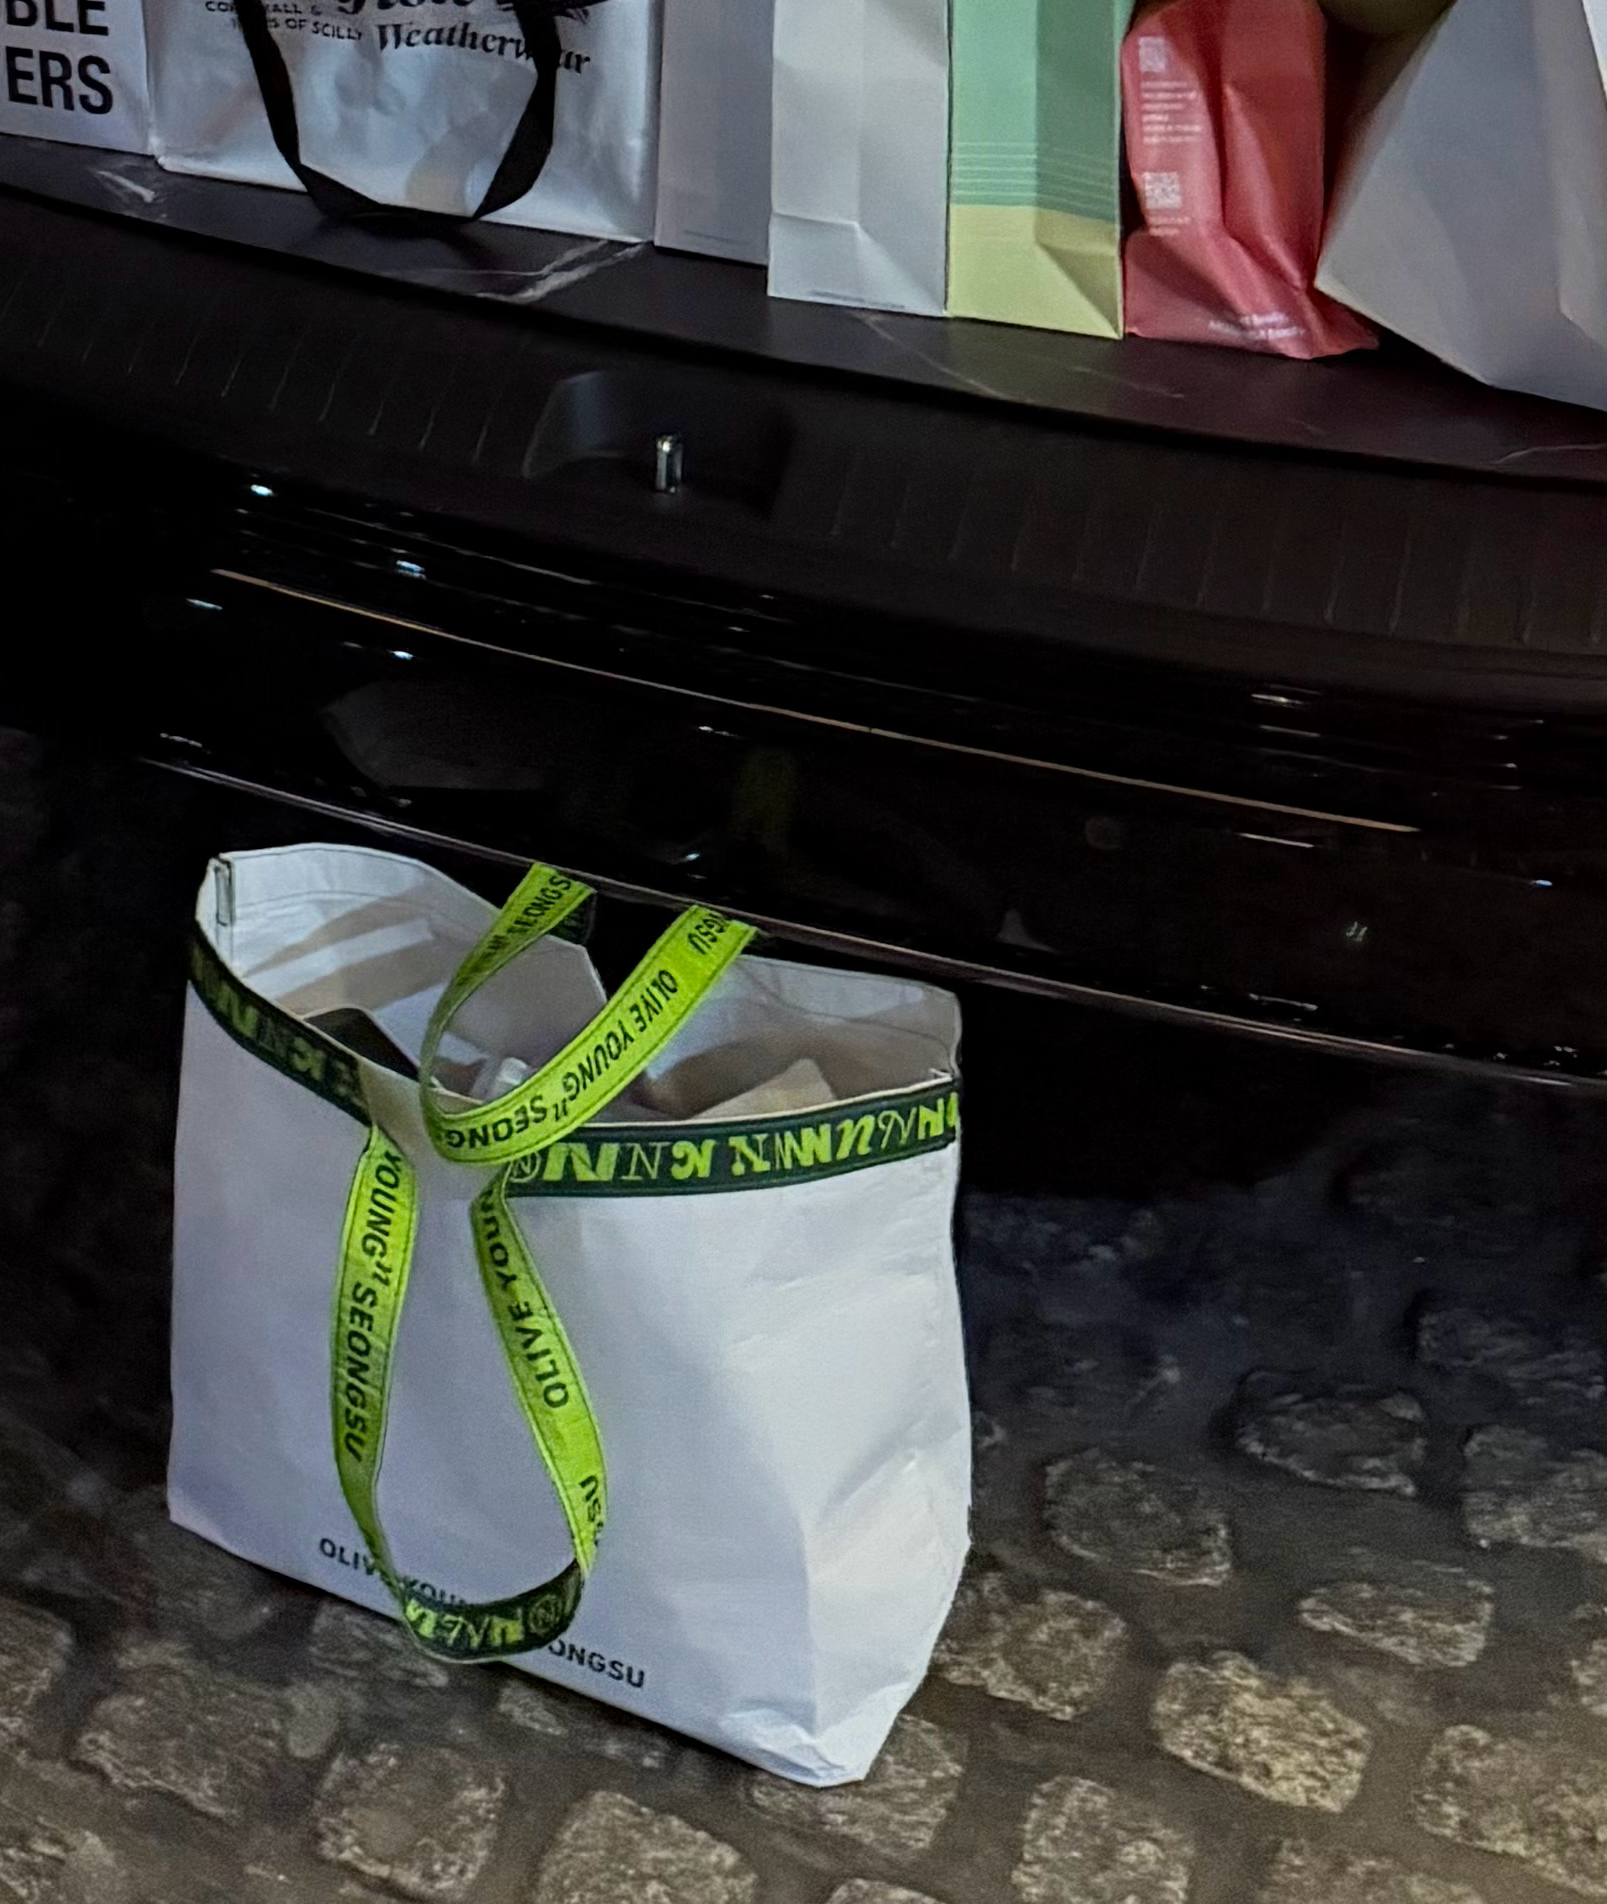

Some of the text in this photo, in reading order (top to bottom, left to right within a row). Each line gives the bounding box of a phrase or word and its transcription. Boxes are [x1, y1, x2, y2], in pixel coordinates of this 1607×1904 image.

[629, 968, 678, 1033] OLIVE
[561, 1019, 634, 1103] YOUNG
[345, 1280, 378, 1463] SEONGSU
[508, 1300, 569, 1409] OLIVE
[319, 1537, 376, 1576] OLIV
